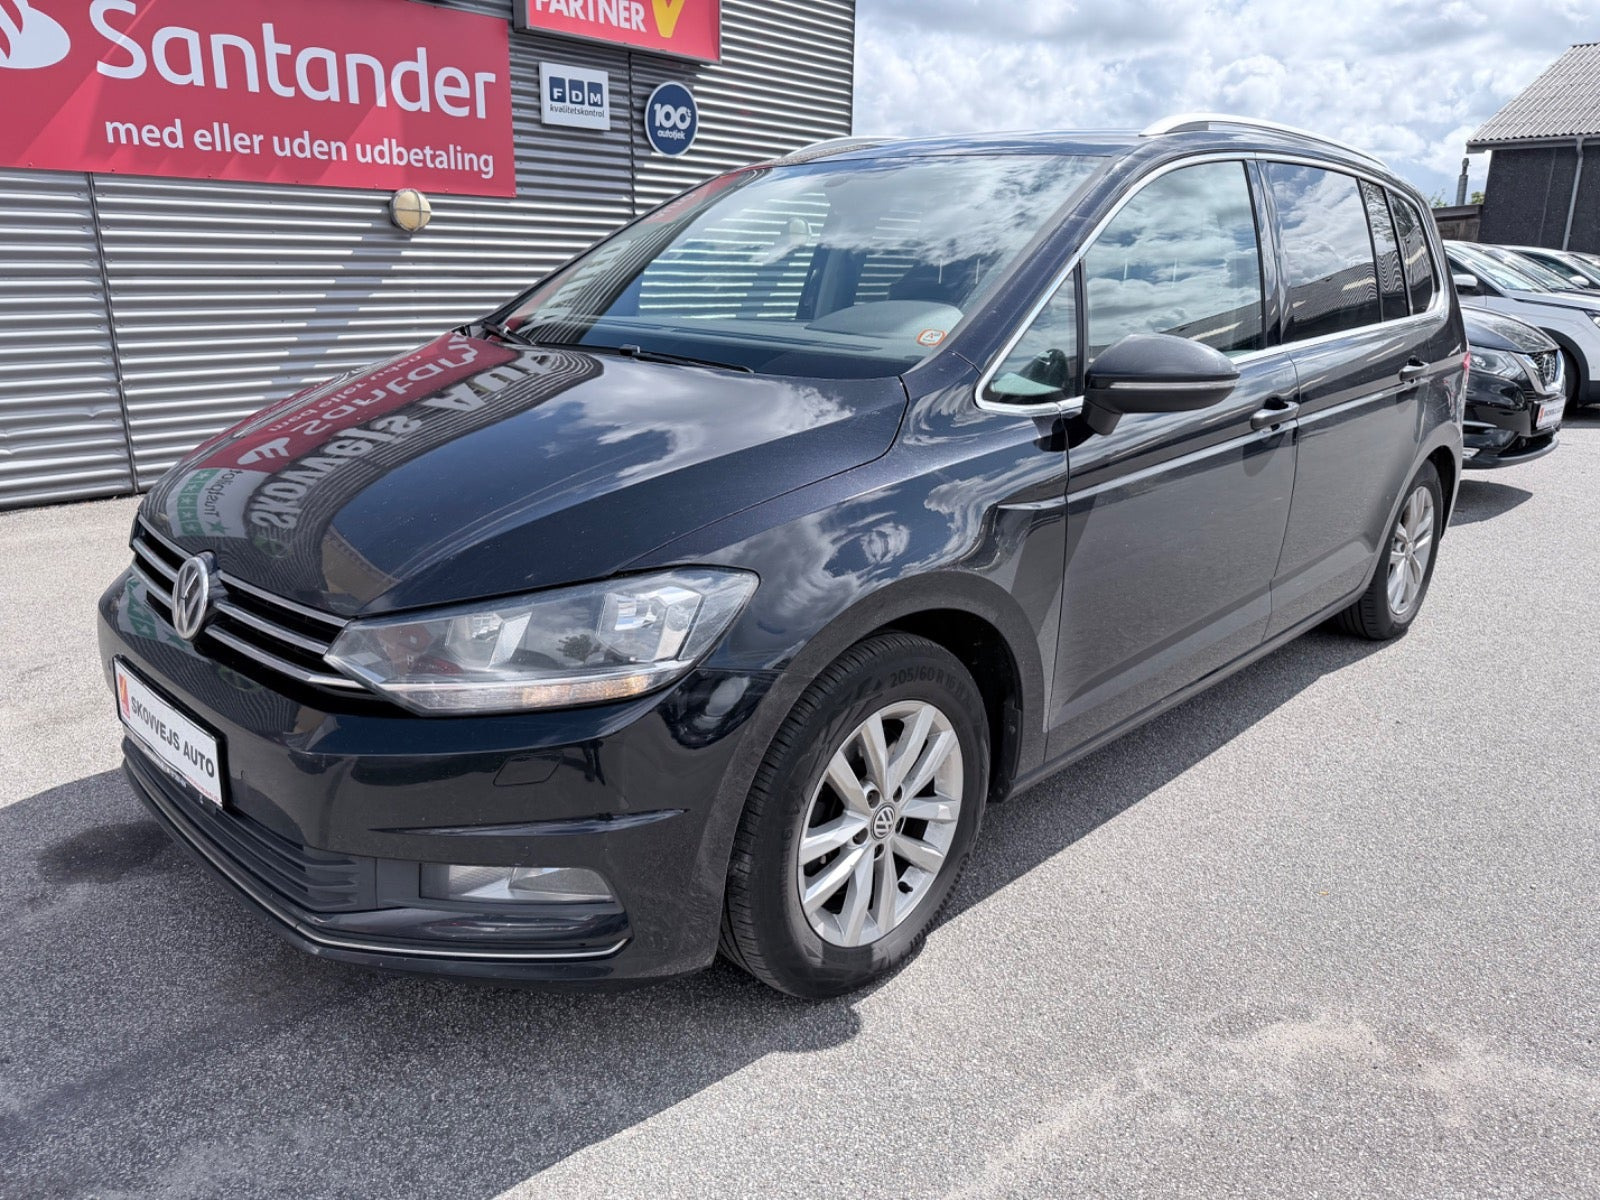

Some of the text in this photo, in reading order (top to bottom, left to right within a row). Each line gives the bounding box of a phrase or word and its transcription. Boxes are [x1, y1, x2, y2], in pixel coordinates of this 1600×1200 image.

[89, 0, 496, 119] Santander
[550, 104, 605, 118] kvalitetskontrol
[553, 87, 602, 105] FDM
[105, 119, 494, 179] med eller uden udbetaling
[890, 663, 935, 688] 205/60
[131, 695, 180, 751] SKOVVEJS
[183, 740, 215, 778] AUTO
